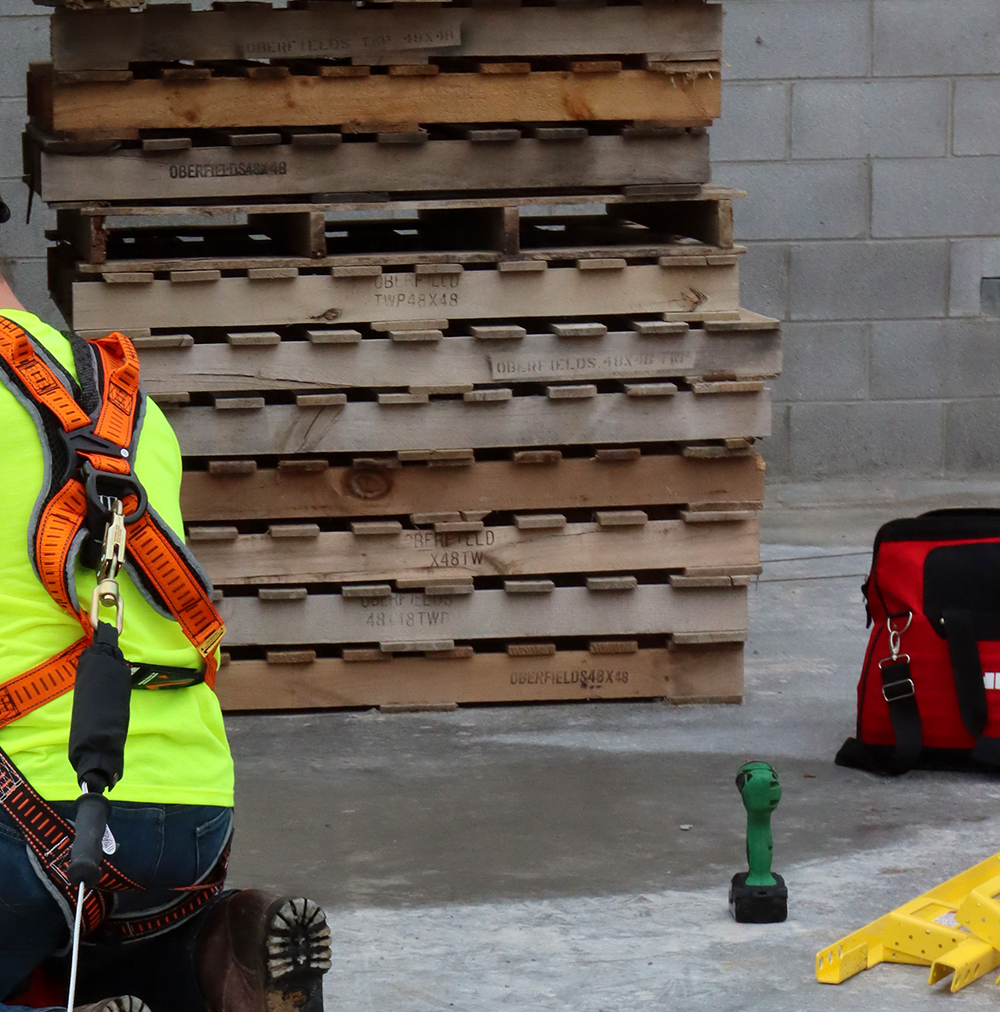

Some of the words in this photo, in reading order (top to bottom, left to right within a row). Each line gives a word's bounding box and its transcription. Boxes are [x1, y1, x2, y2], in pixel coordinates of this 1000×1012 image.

[246, 39, 350, 54] OBERFIELDS
[374, 292, 459, 308] TWP48X48
[430, 550, 485, 568] X48TW
[510, 669, 629, 686] OBERFIELDS48X48
